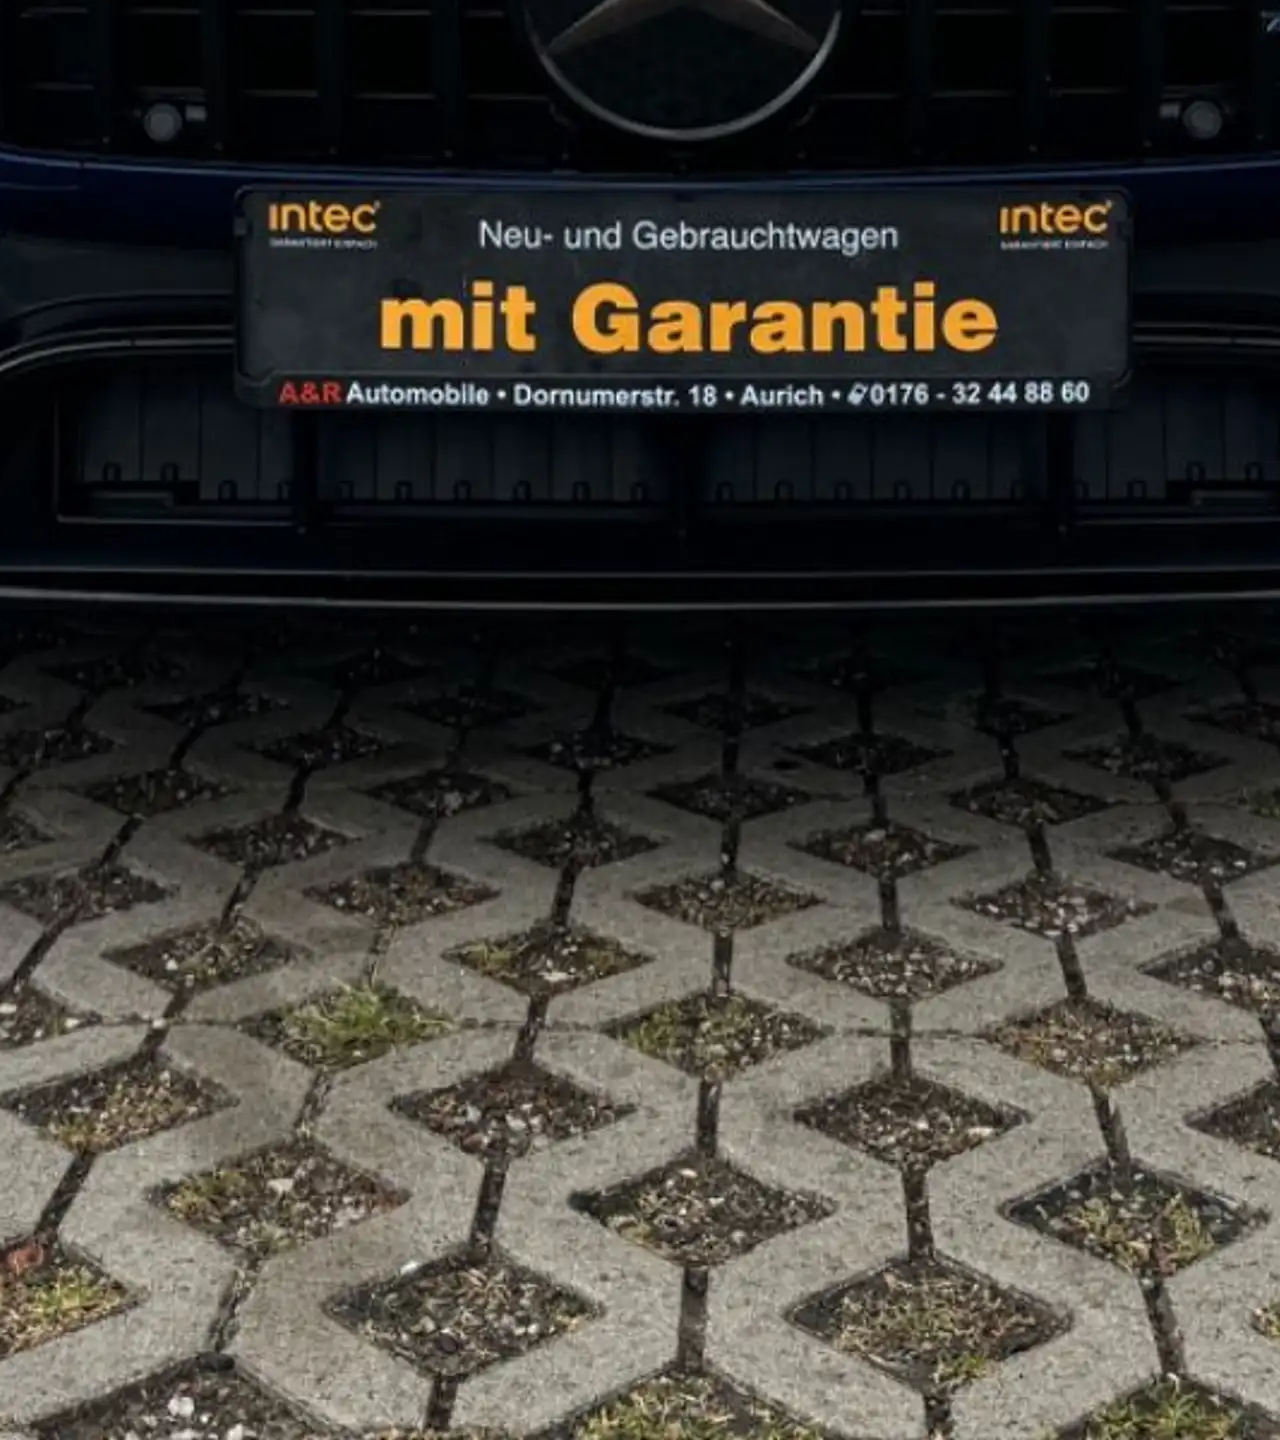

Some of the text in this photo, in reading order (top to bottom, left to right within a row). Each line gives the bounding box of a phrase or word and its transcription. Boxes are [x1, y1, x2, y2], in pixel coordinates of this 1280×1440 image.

[268, 200, 378, 233] intec
[999, 201, 1109, 234] intec
[478, 219, 899, 257] Neu- und Gebrauchtwagen
[379, 279, 999, 353] mit Garantie
[279, 382, 343, 404] A&R
[346, 381, 489, 406] Automobile
[513, 382, 680, 407] Dornumerstr.
[688, 384, 718, 407] 18
[740, 384, 824, 406] Aurich
[869, 383, 930, 405] 0176
[951, 382, 981, 405] 32
[987, 382, 1018, 404] 44
[1023, 381, 1054, 404] 88
[1060, 381, 1090, 403] 60
